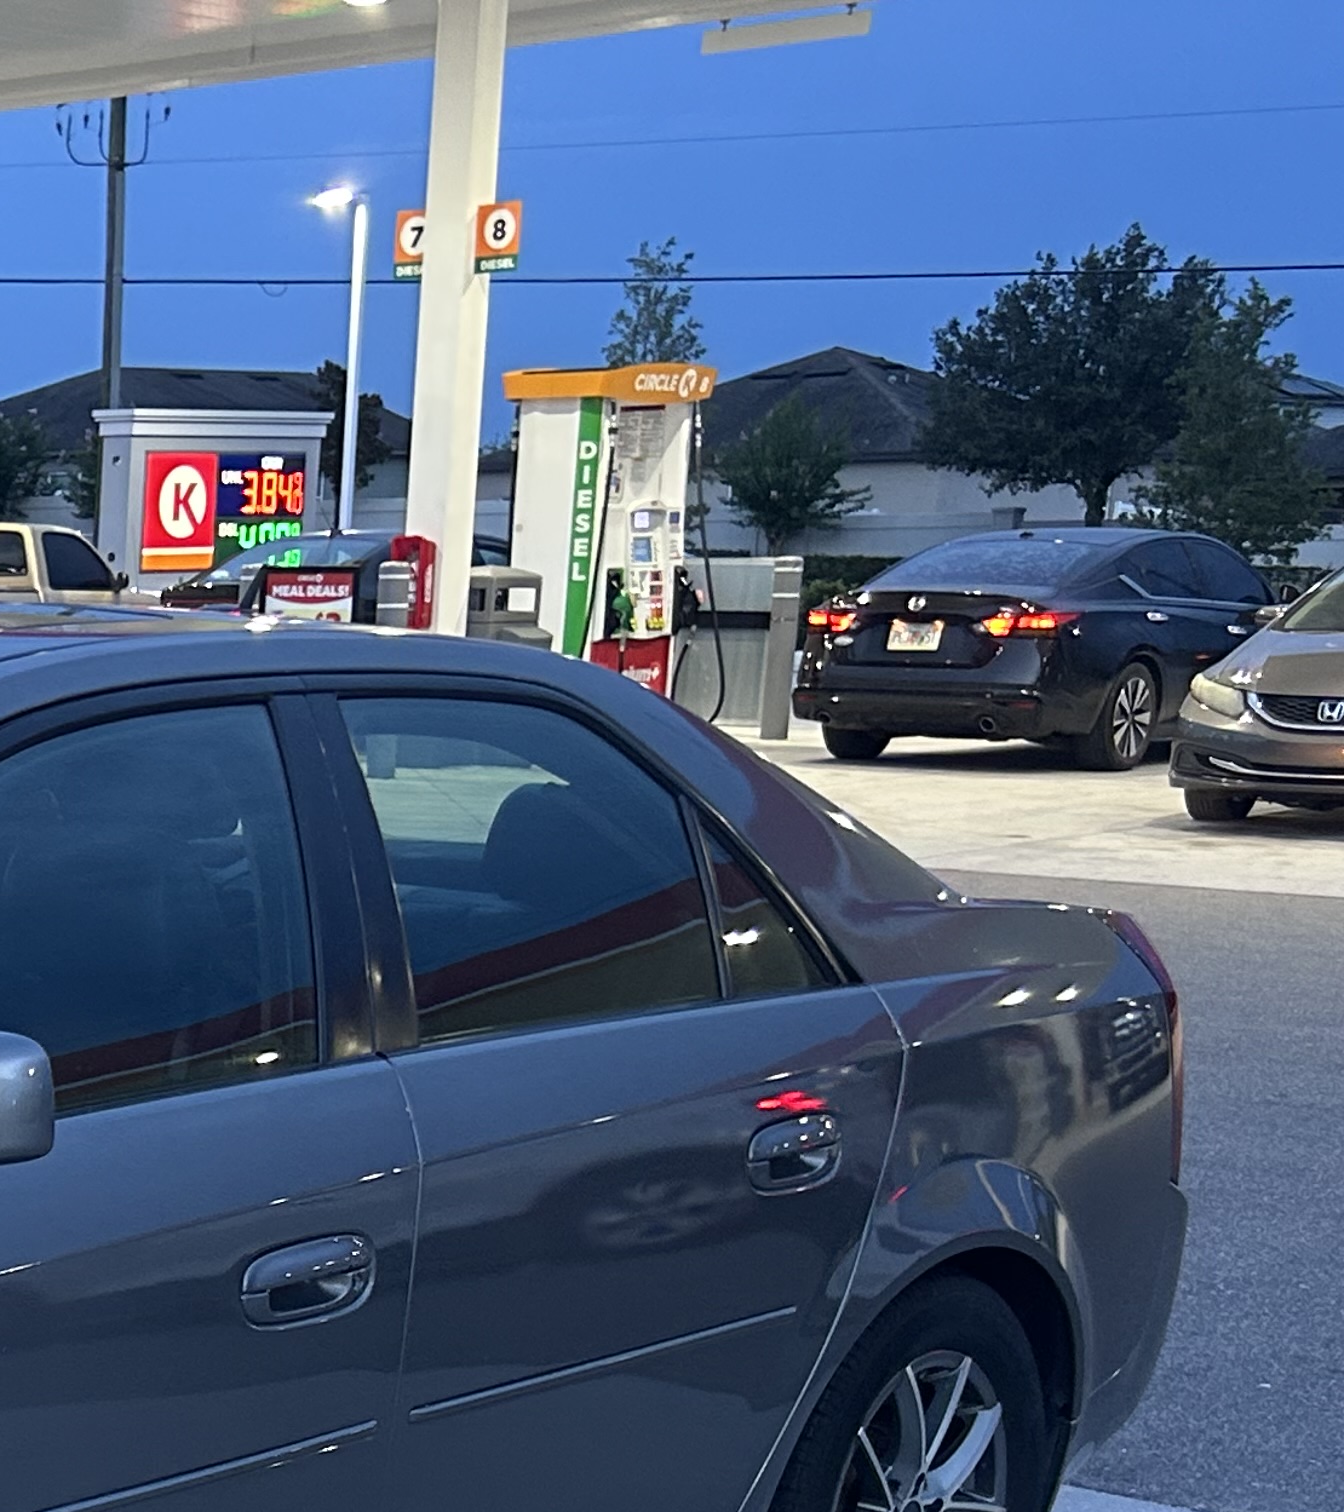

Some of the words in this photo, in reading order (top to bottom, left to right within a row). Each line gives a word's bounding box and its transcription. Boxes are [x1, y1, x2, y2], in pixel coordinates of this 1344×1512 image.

[410, 226, 424, 248] 7
[492, 219, 506, 241] 8
[480, 258, 515, 271] DIESEL
[634, 373, 679, 392] CIRCLE
[679, 369, 697, 397] K
[699, 376, 710, 393] 8
[572, 441, 597, 581] DIESEL
[272, 585, 305, 597] MEAL
[306, 585, 350, 597] DEALS!
